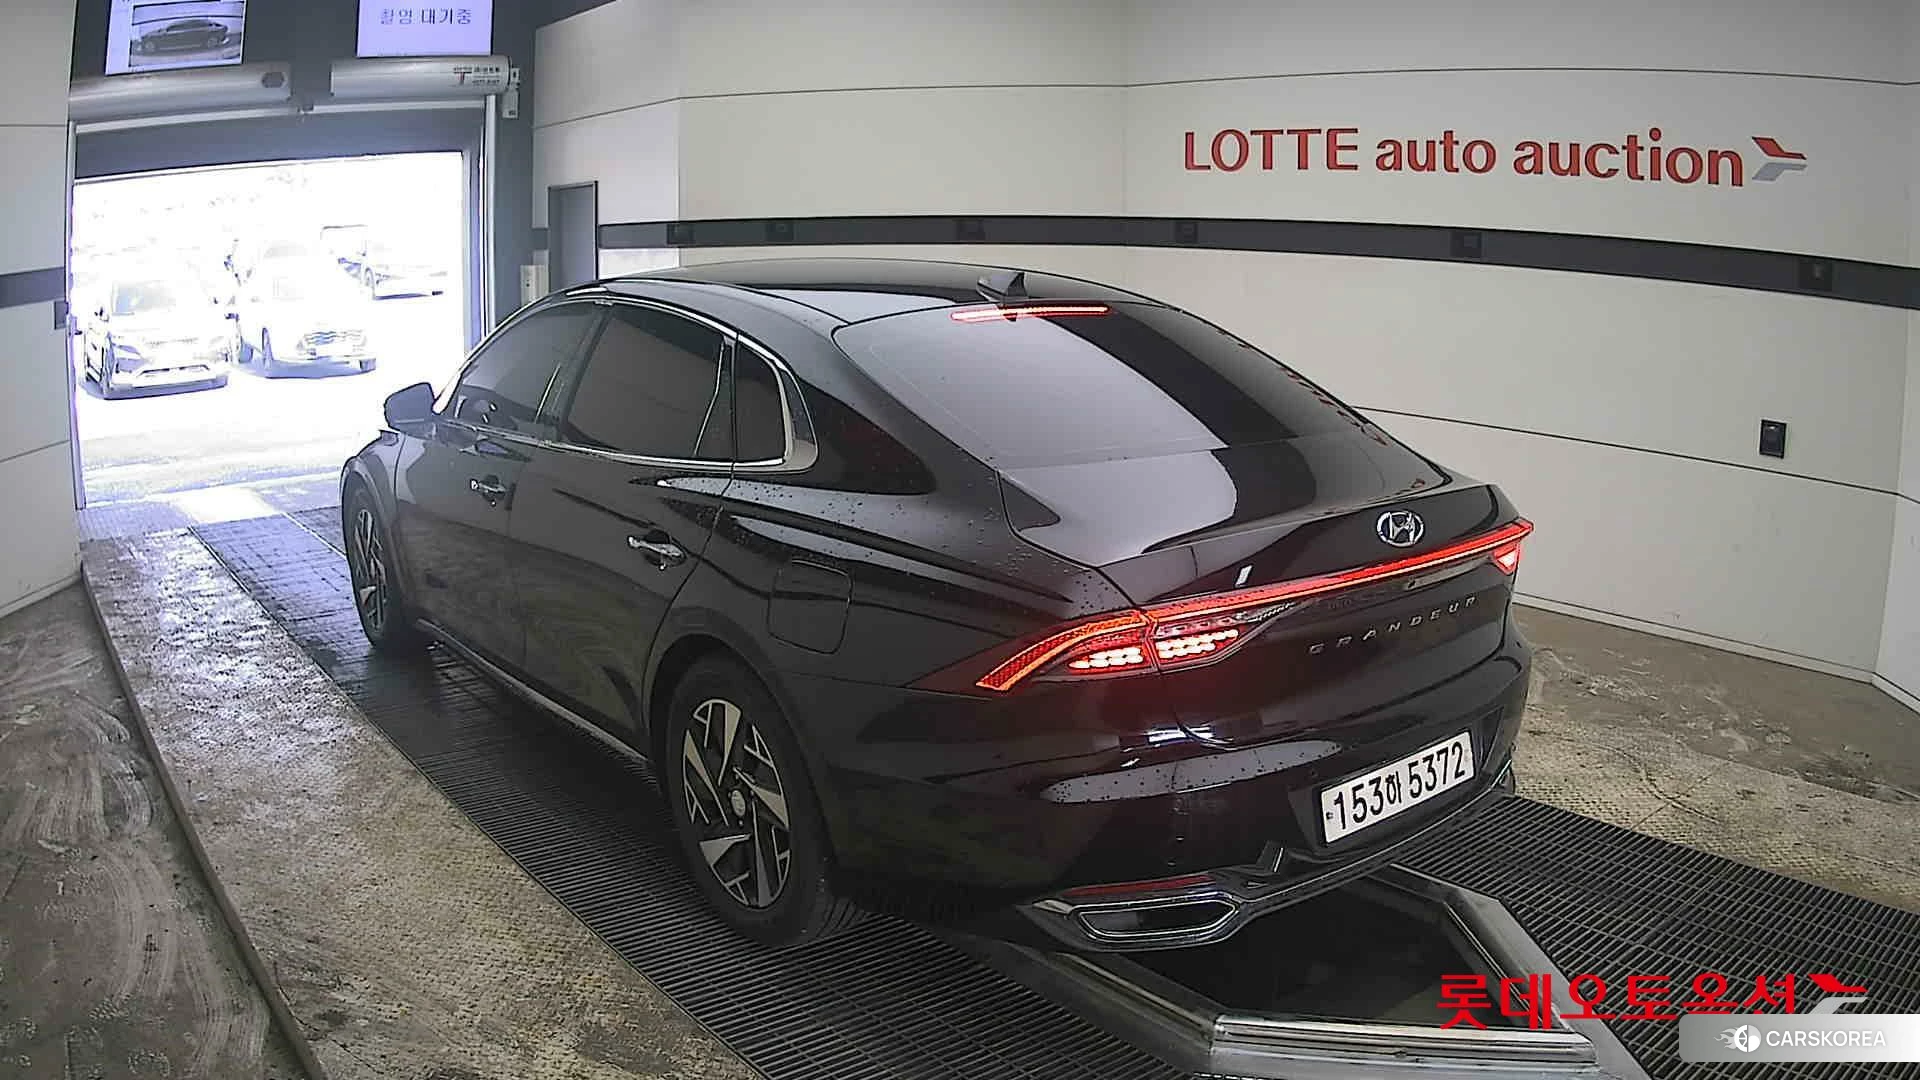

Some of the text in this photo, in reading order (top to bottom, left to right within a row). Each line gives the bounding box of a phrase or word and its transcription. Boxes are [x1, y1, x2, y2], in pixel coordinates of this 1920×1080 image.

[421, 7, 473, 25] 대기중
[1184, 127, 1744, 187] LOTTE auto auction
[1309, 595, 1476, 655] GRANDEUR
[1333, 741, 1466, 830] 153하 5372
